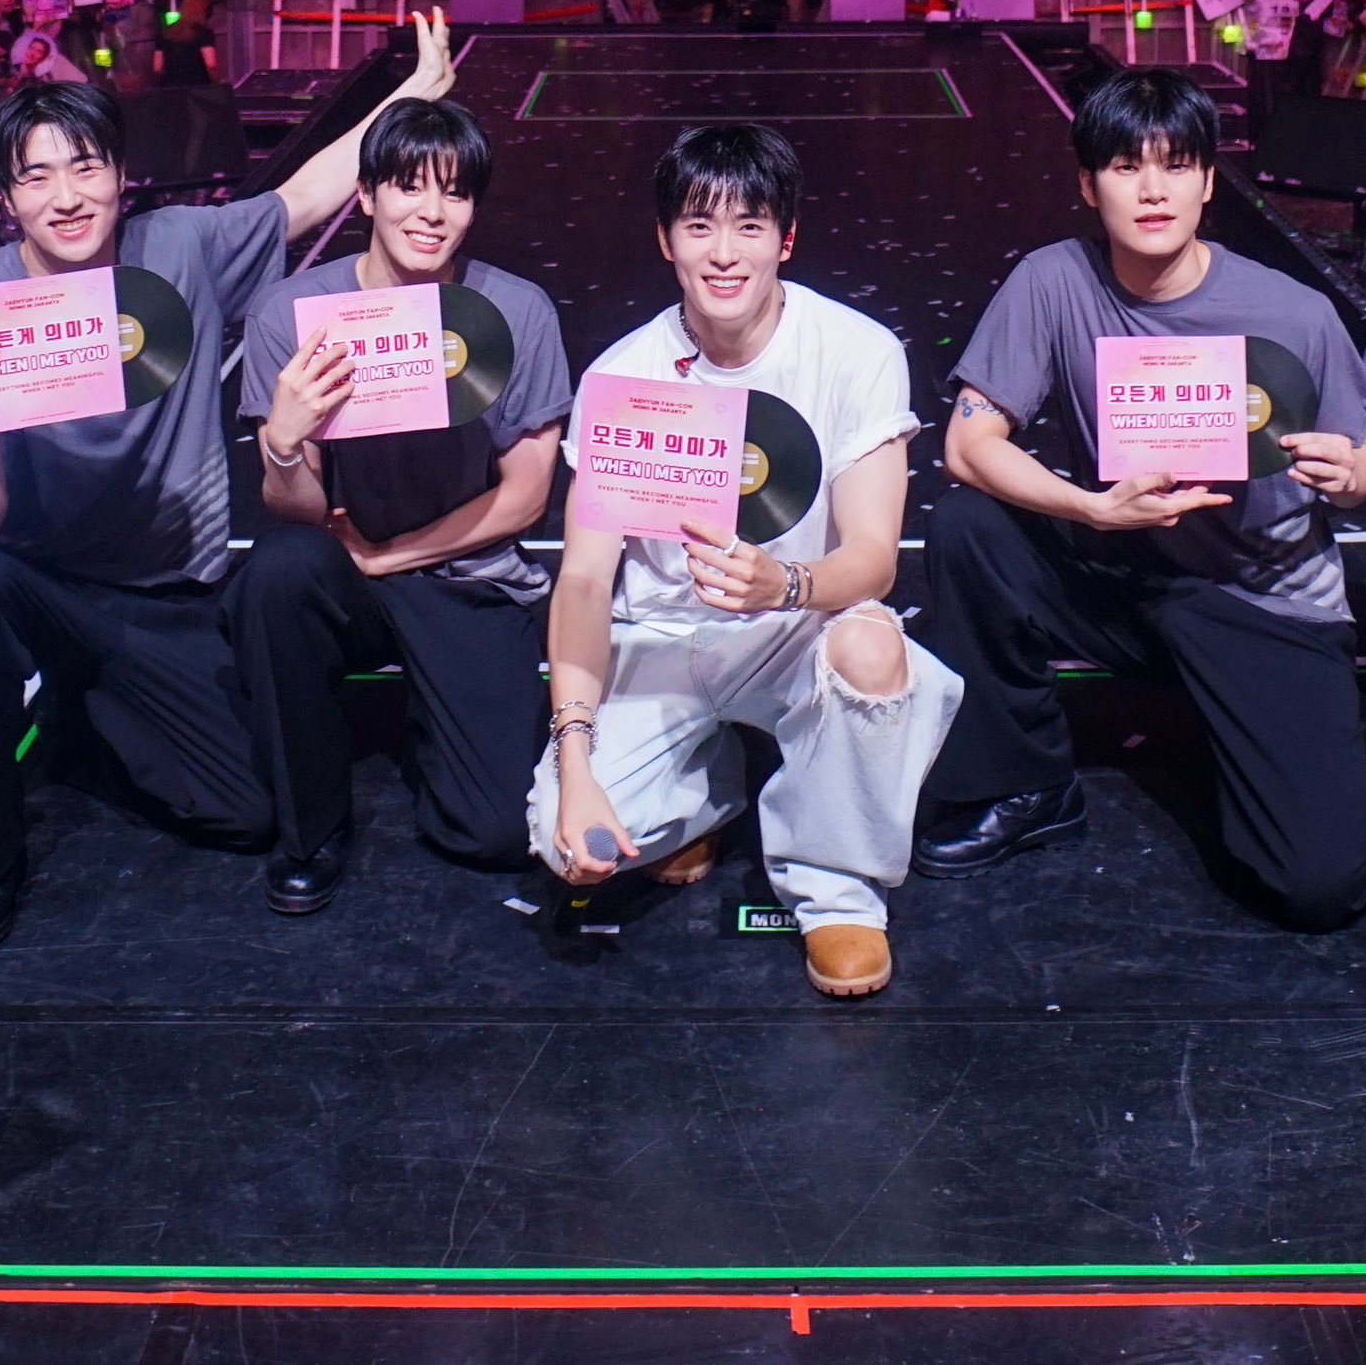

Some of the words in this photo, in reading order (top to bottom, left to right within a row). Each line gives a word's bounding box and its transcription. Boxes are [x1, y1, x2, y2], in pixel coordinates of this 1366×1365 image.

[45, 317, 104, 342] 의미가
[375, 332, 429, 354] 의미가
[30, 356, 40, 371] I
[41, 350, 75, 370] MET
[72, 344, 109, 364] YOU
[371, 363, 401, 381] MET
[399, 359, 434, 376] YOU
[1110, 385, 1166, 402] 모든게
[1176, 384, 1232, 402] 의미가
[1110, 413, 1159, 429] WHEN
[1160, 413, 1168, 428] I
[1169, 413, 1205, 428] MET
[1202, 412, 1235, 427] YOU
[592, 424, 654, 451] 모든게
[664, 434, 728, 459] 의미가
[590, 456, 642, 478] WHEN
[644, 462, 652, 479] I
[654, 464, 692, 484] MET
[691, 468, 729, 488] YOU
[751, 913, 799, 927] MON
